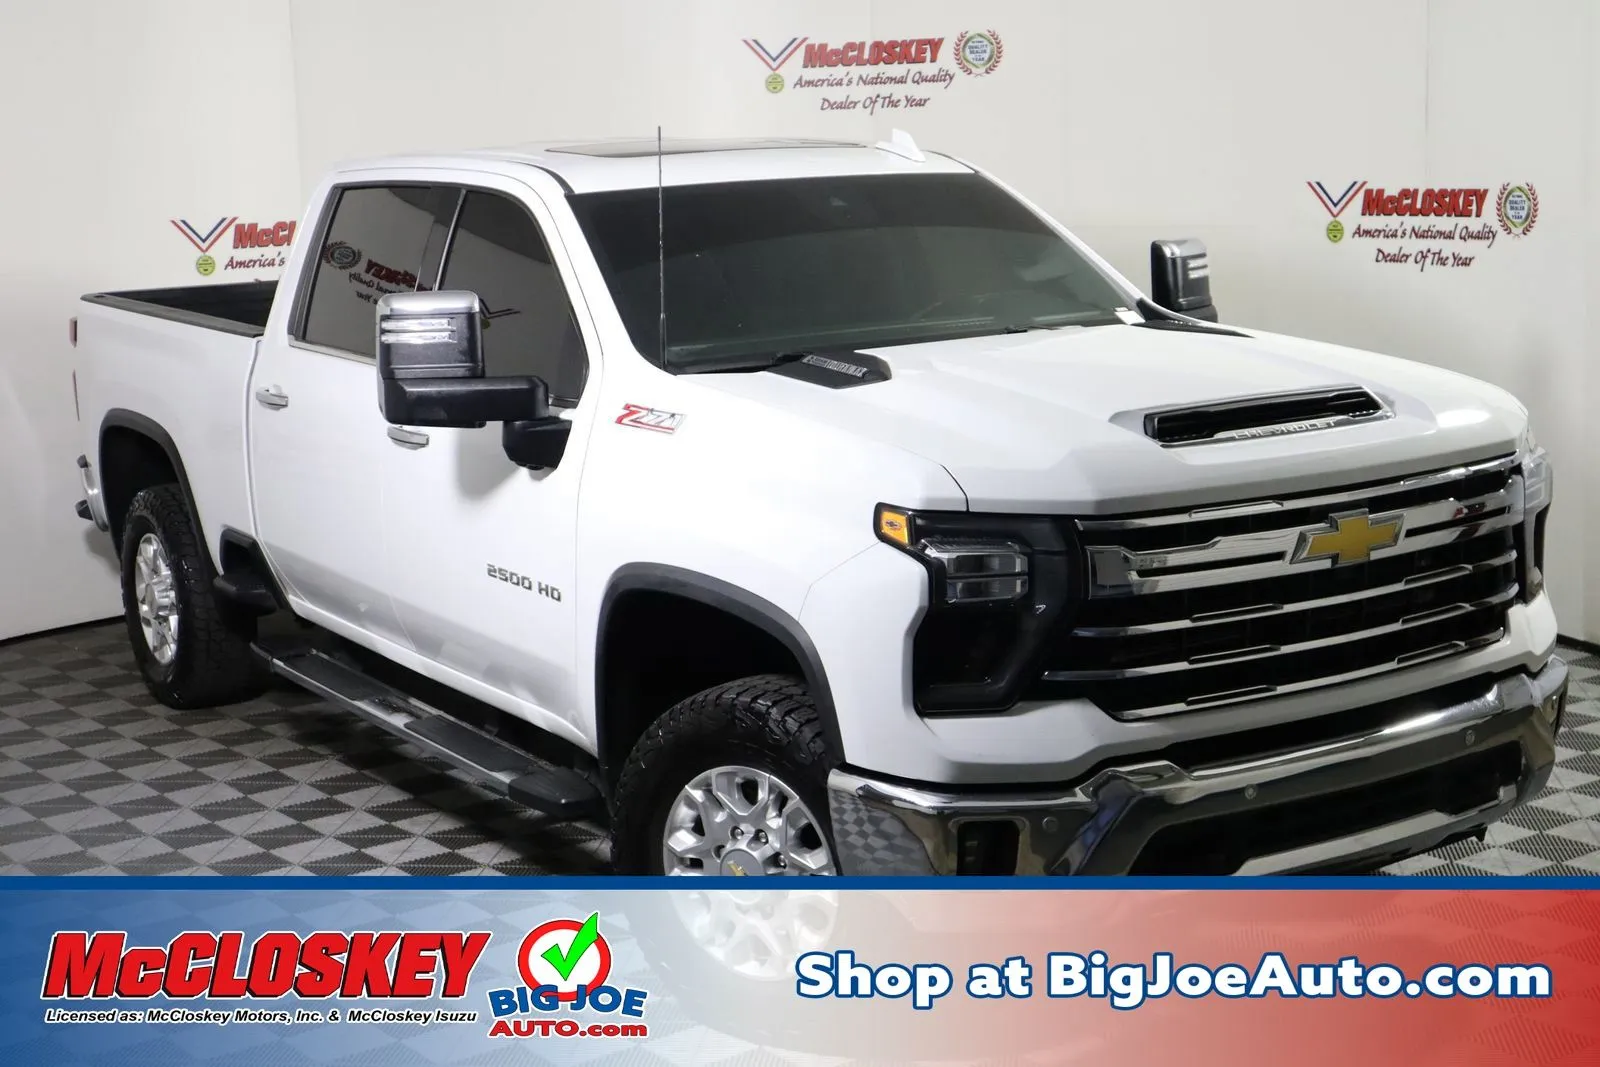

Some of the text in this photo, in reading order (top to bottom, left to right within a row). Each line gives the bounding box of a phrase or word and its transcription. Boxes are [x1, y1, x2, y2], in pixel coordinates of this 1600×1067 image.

[802, 37, 944, 68] McCLOSKEY
[793, 67, 956, 89] America's National Quality
[820, 93, 930, 116] Dealer Of The Year
[1361, 188, 1489, 217] McCLOSKEY
[1352, 221, 1497, 248] America's National Quality
[224, 251, 285, 271] America's
[1375, 246, 1475, 272] Dealer Of The Year
[1233, 418, 1337, 439] CHEVROLET
[487, 562, 562, 603] 2500 HD
